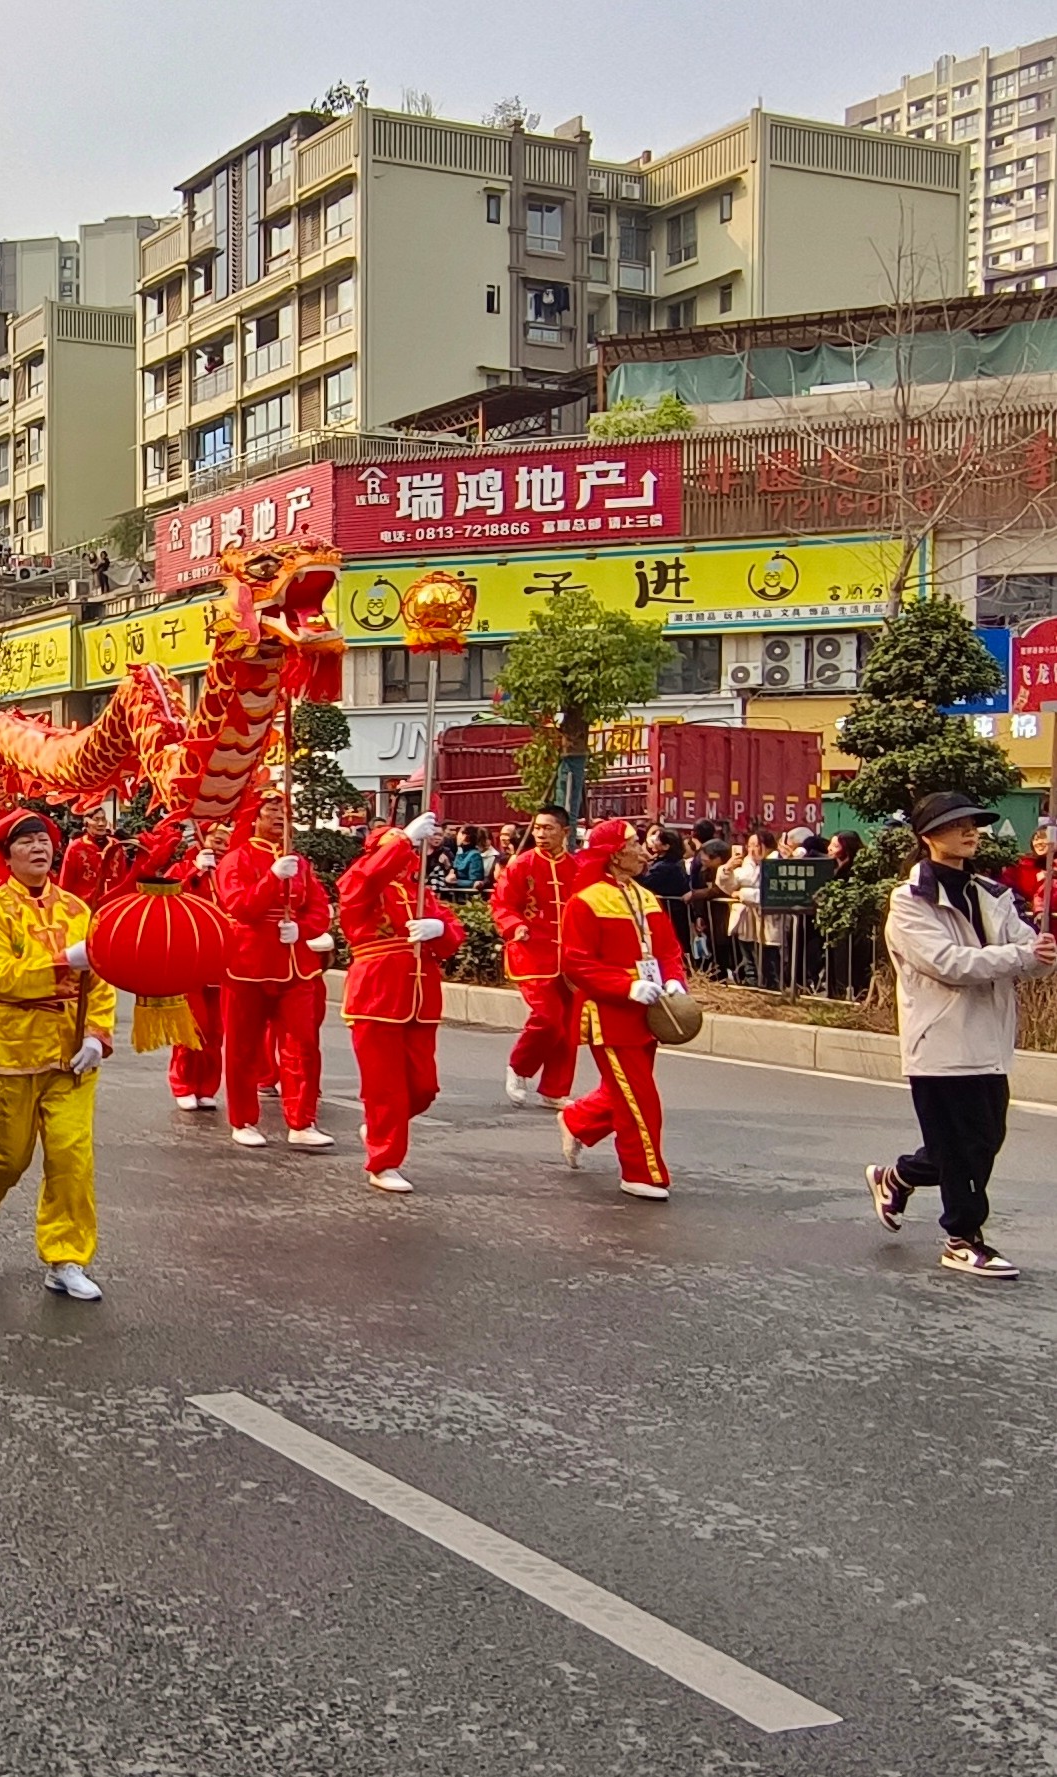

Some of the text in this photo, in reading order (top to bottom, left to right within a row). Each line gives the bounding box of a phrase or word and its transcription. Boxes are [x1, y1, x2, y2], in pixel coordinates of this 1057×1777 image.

[190, 486, 312, 559] 瑞鸿地产
[396, 461, 626, 521] 瑞鸿地产
